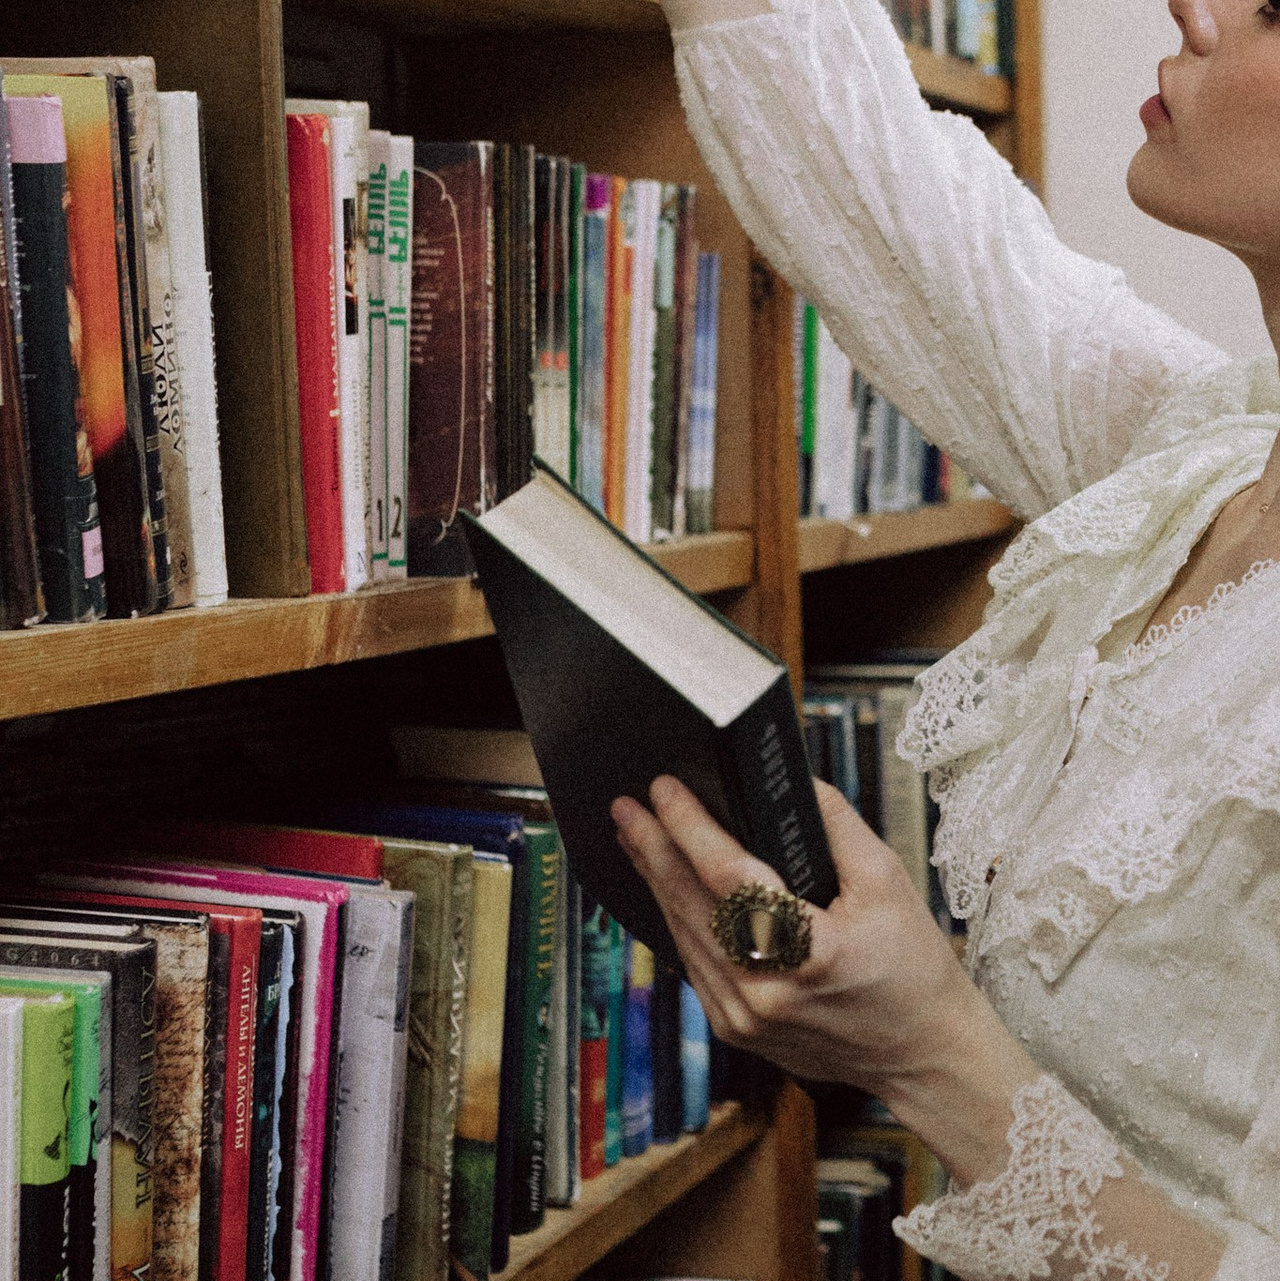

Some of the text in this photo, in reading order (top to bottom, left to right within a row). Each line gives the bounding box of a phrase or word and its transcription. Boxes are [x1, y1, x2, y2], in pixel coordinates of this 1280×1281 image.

[390, 495, 404, 540] 2
[238, 964, 252, 1041] АНГЕЛЫ
[234, 1061, 248, 1150] ДЕМОНЫ
